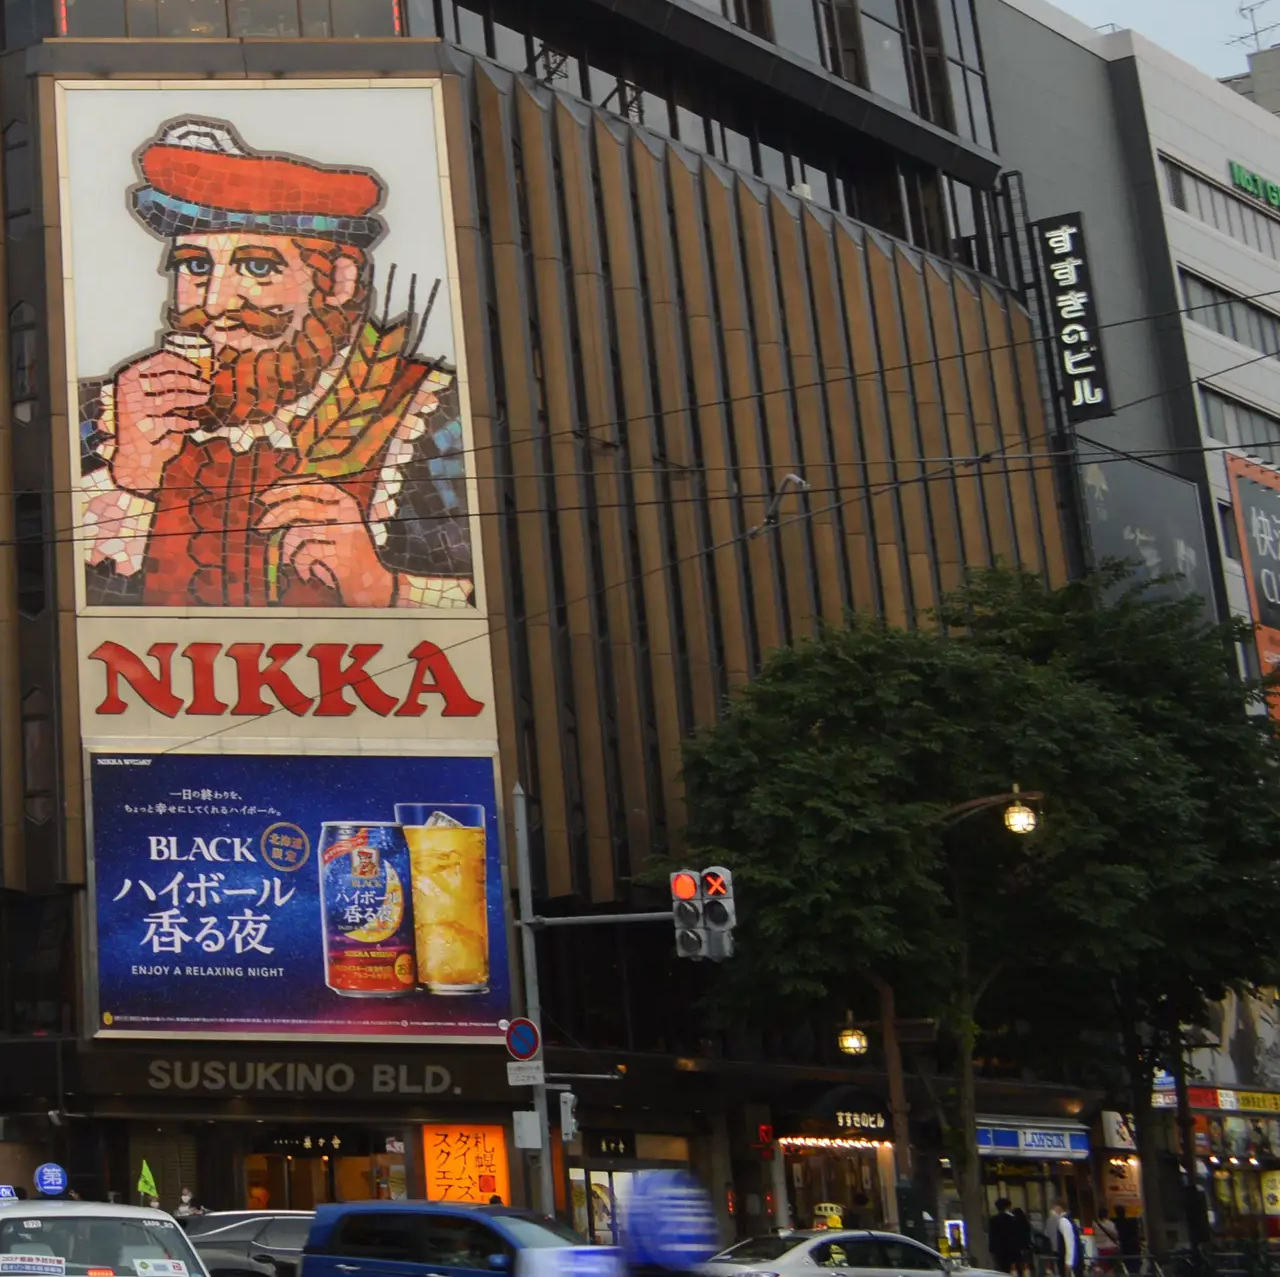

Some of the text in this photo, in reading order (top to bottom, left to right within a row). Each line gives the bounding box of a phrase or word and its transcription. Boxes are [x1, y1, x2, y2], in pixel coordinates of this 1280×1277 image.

[1044, 224, 1104, 407] すすきのビル
[87, 640, 486, 719] NIKKA
[123, 801, 282, 817] ちょっと幸せにしてくれるハイボール。
[169, 788, 243, 802] 一日の終わりを、
[147, 835, 258, 863] BLACK
[112, 870, 297, 908] ハイボール
[139, 908, 276, 954] 香る夜
[131, 965, 285, 978] ENJOY A RELAXING NIGHT
[148, 1059, 462, 1096] SUSUKINO BLD.
[434, 1132, 454, 1201] スクエア
[454, 1132, 477, 1200] タイムズ
[473, 1132, 496, 1174] 札幌
